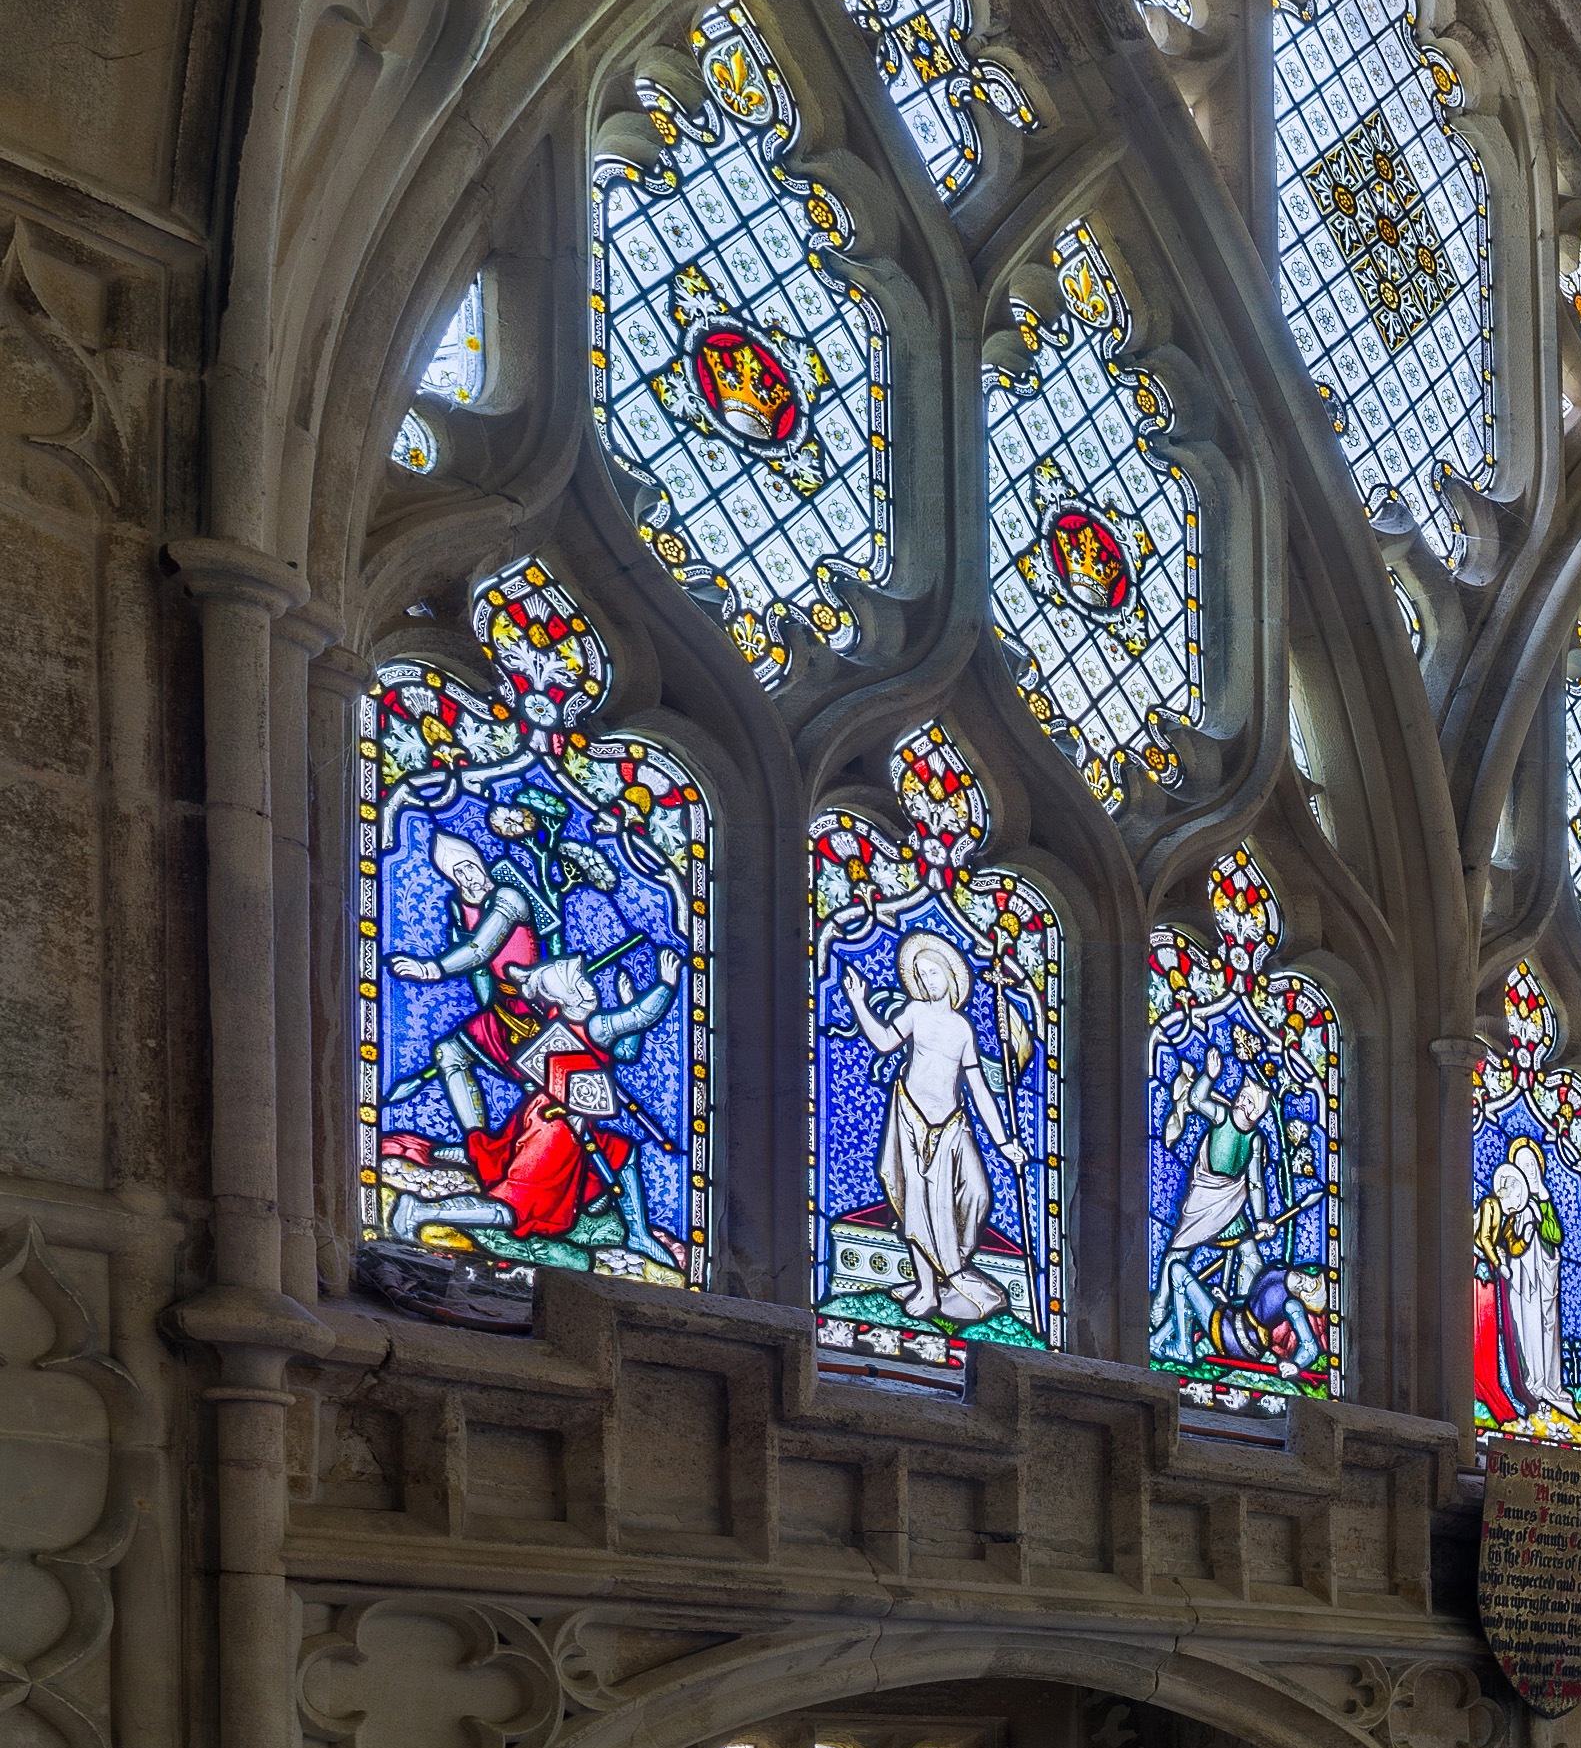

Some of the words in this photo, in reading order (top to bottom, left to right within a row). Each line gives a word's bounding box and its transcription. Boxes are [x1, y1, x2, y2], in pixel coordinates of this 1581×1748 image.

[1488, 1451, 1518, 1479] This
[1520, 1457, 1579, 1486] Window
[1495, 1500, 1537, 1525] James
[1481, 1520, 1514, 1549] Judge
[1515, 1526, 1529, 1543] of
[1528, 1527, 1568, 1555] County
[1488, 1544, 1502, 1570] by
[1504, 1546, 1520, 1568] the
[1521, 1547, 1564, 1571] Officers
[1565, 1553, 1578, 1571] of
[1480, 1565, 1503, 1588] who
[1506, 1573, 1555, 1592] respected
[1556, 1575, 1575, 1593] and
[1494, 1594, 1509, 1608] an
[1510, 1592, 1551, 1616] upright
[1551, 1596, 1571, 1614] and
[1504, 1613, 1528, 1635] who
[1530, 1619, 1567, 1635] mourn
[1515, 1637, 1534, 1653] and
